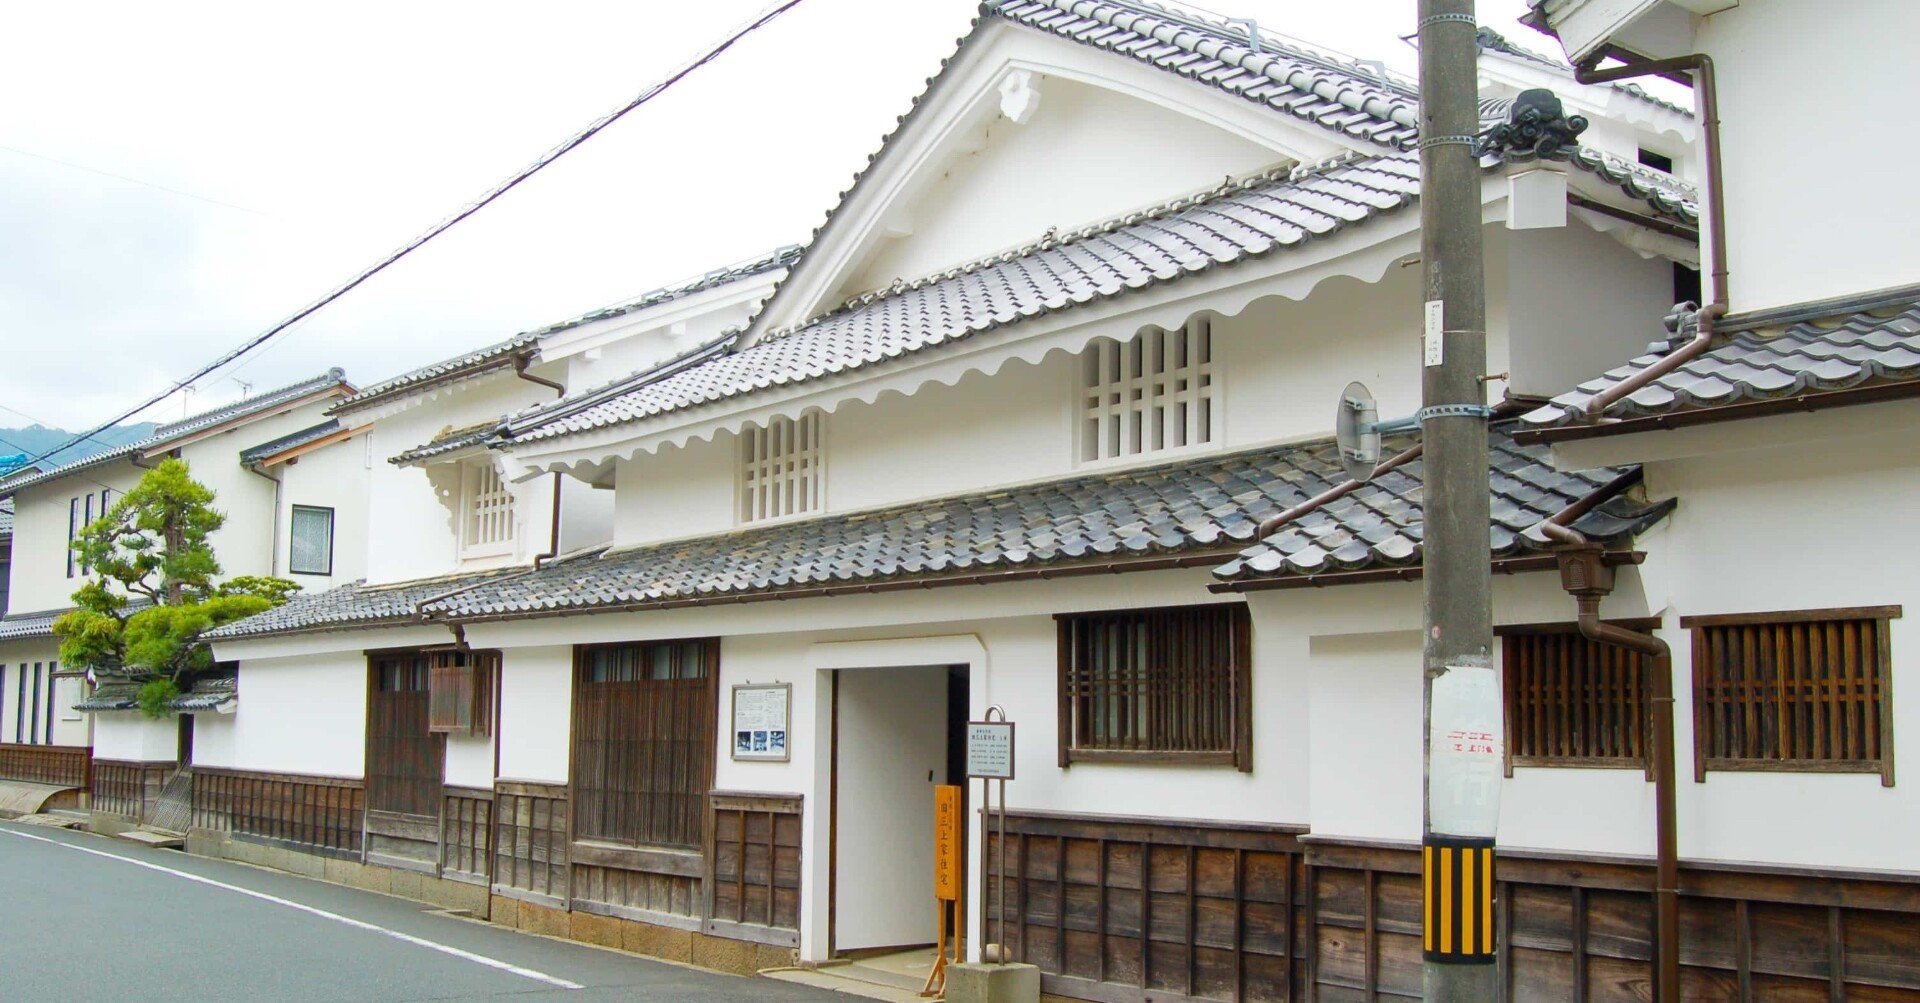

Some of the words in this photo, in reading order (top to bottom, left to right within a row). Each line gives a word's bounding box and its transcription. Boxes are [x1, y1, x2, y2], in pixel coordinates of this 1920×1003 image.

[940, 803, 949, 886] 旧三上家住宅
